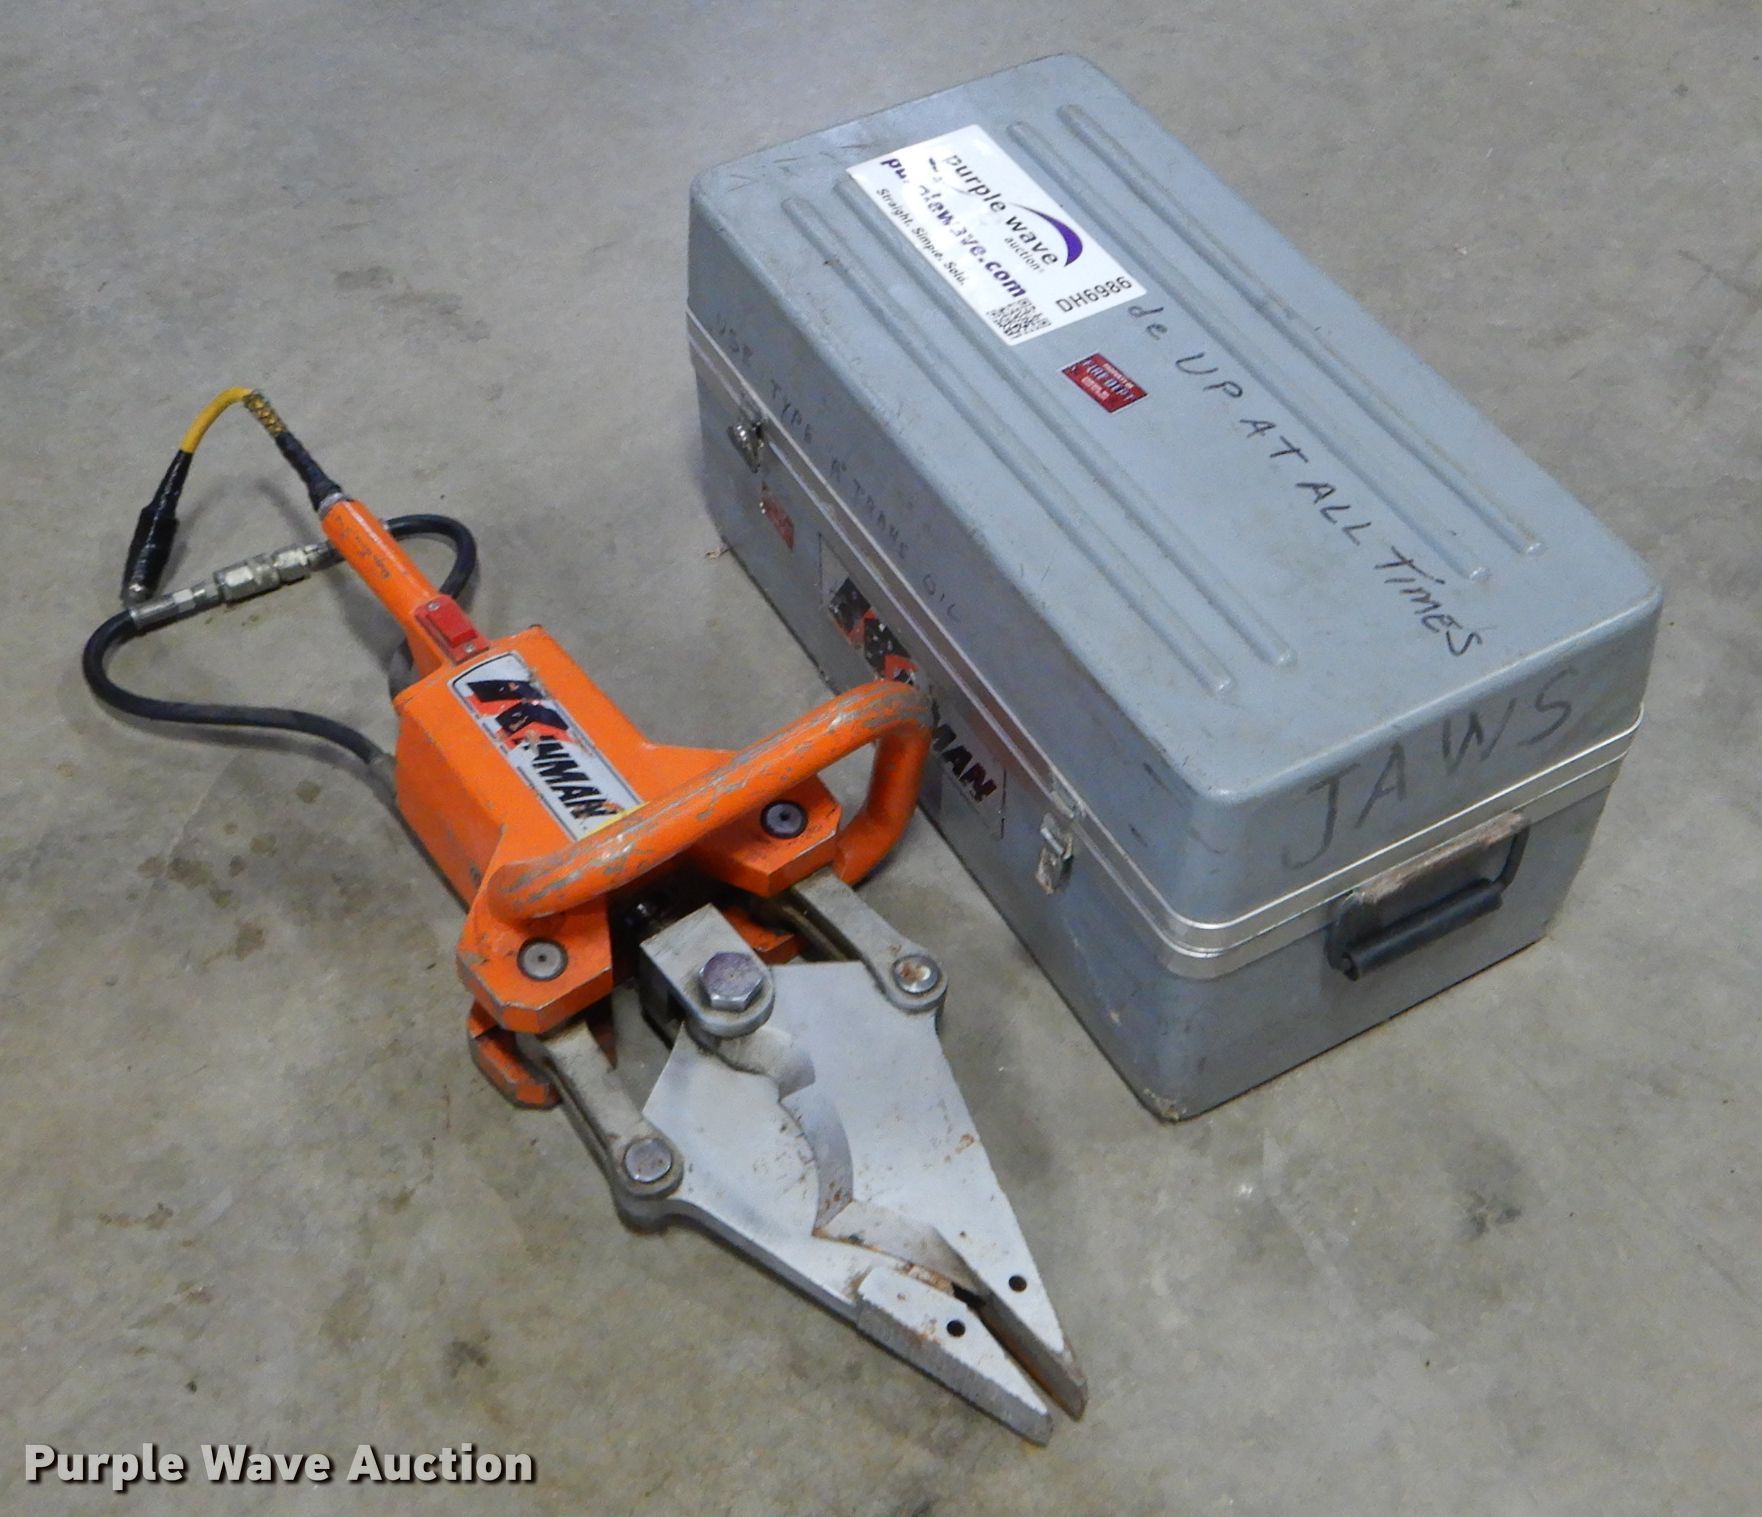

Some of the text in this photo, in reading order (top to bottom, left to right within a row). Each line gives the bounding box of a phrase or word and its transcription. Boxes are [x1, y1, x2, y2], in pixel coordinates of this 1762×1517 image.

[1006, 216, 1058, 265] wave
[1055, 276, 1132, 313] DH6986
[1175, 352, 1243, 398] UP
[1239, 419, 1309, 463] AT
[1296, 482, 1371, 546] ALL
[1281, 664, 1578, 870] JAWS
